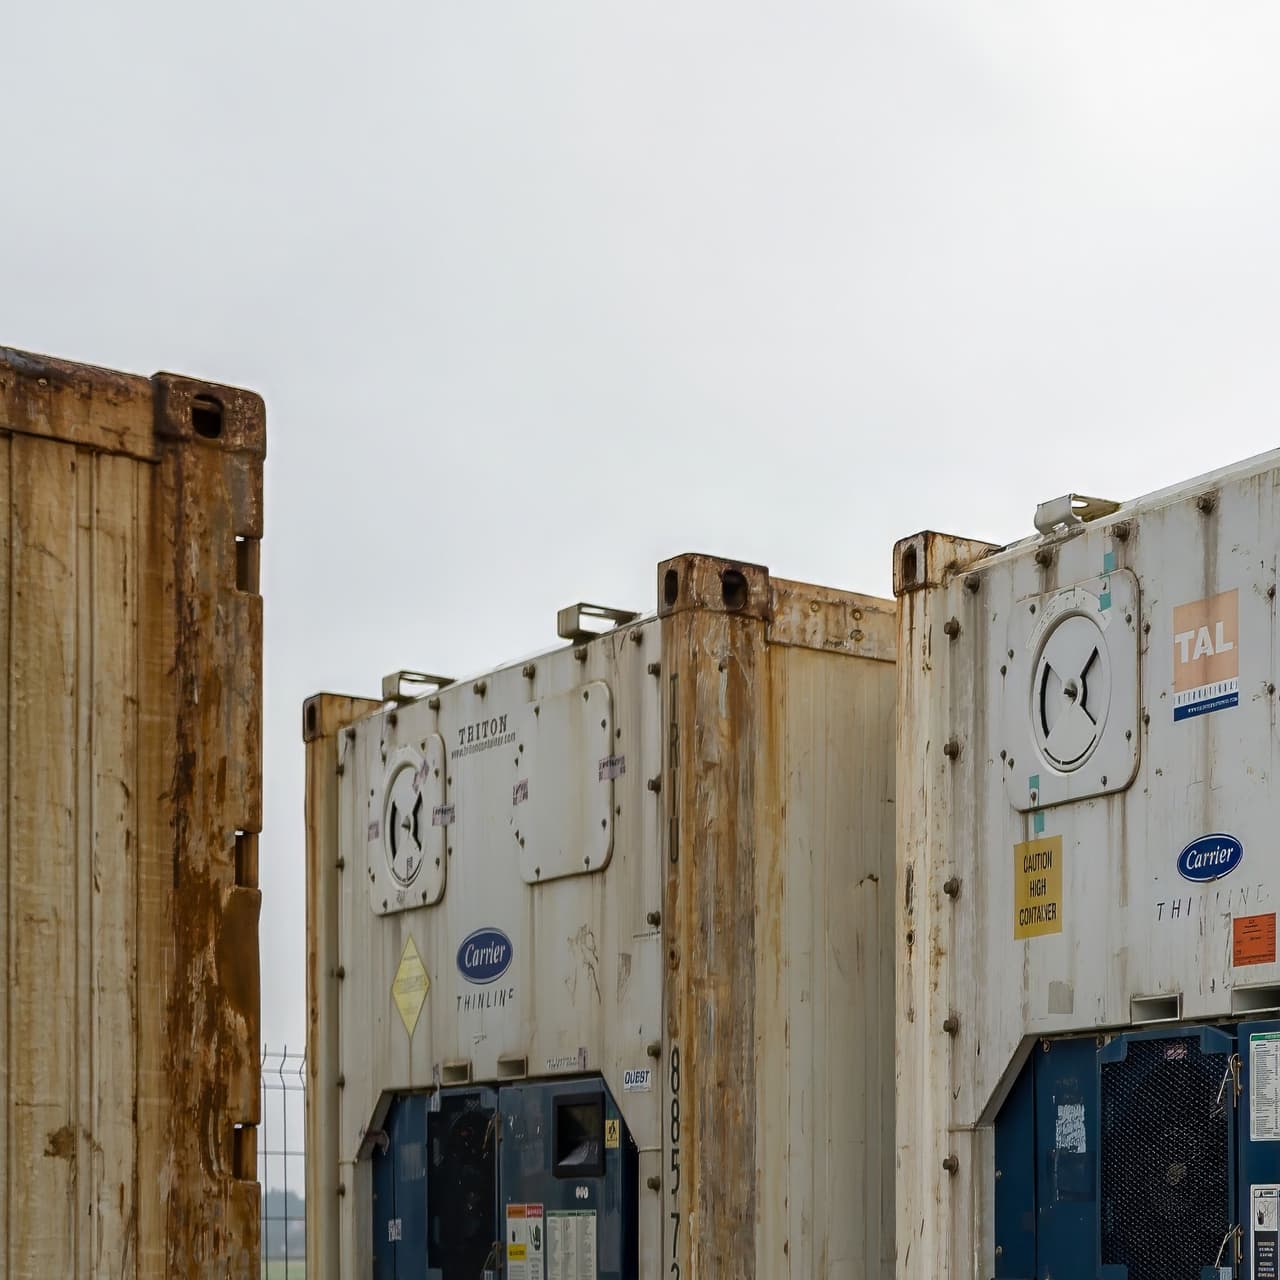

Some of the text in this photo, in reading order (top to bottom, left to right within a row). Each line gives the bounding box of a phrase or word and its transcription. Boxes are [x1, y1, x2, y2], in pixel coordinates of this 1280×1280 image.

[1174, 620, 1234, 664] TAL
[458, 714, 508, 746] TRITON
[1023, 850, 1053, 873] CAUTION
[1186, 845, 1234, 870] Carrier
[1029, 878, 1047, 898] HIGH
[1019, 902, 1057, 926] CONTAINER
[465, 940, 506, 968] Carrier
[457, 988, 514, 1011] THINLINE
[624, 1070, 650, 1085] QUEST
